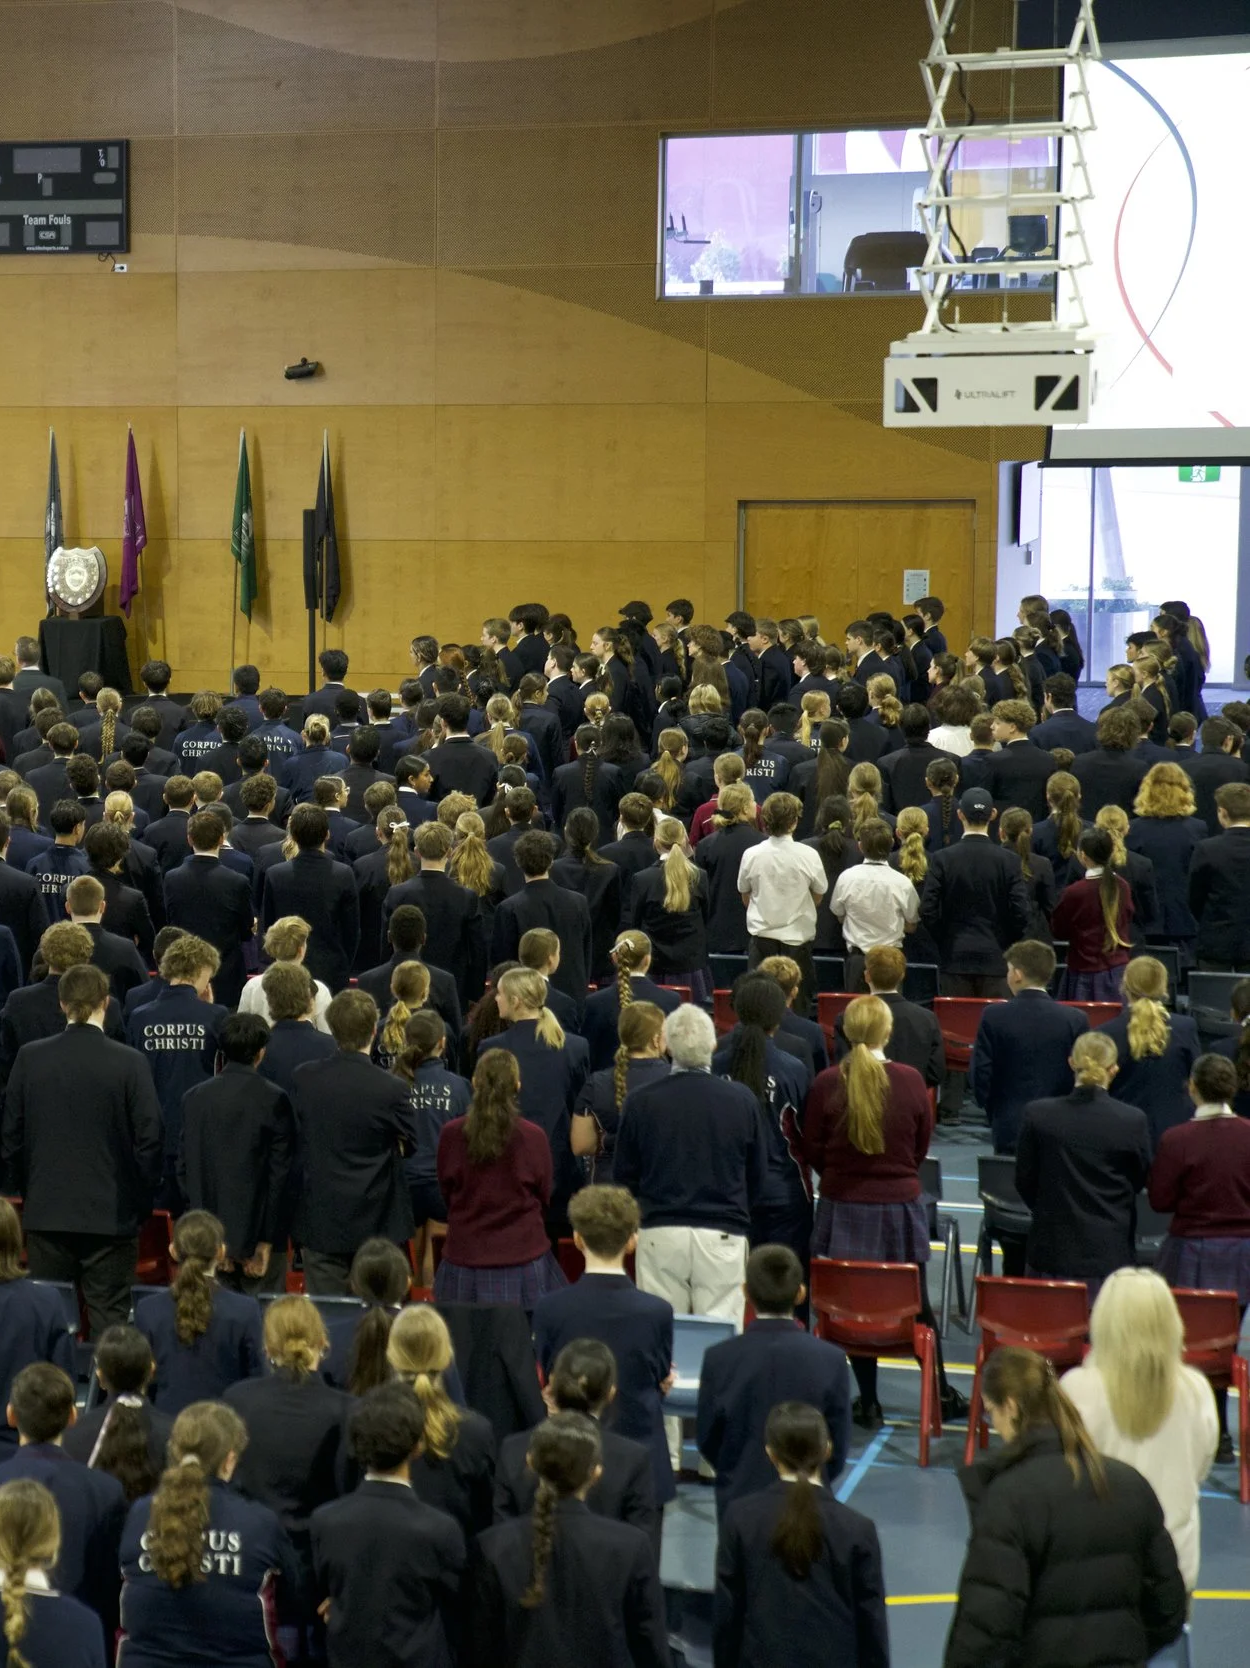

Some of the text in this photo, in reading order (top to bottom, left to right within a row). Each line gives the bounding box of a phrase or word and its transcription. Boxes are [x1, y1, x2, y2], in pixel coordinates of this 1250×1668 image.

[37, 172, 43, 184] P
[23, 214, 71, 225] Team Fouls
[746, 768, 775, 777] RISTI
[143, 1023, 206, 1037] CORPUS
[144, 1037, 206, 1051] CHRISTI
[409, 1097, 451, 1111] RISTI
